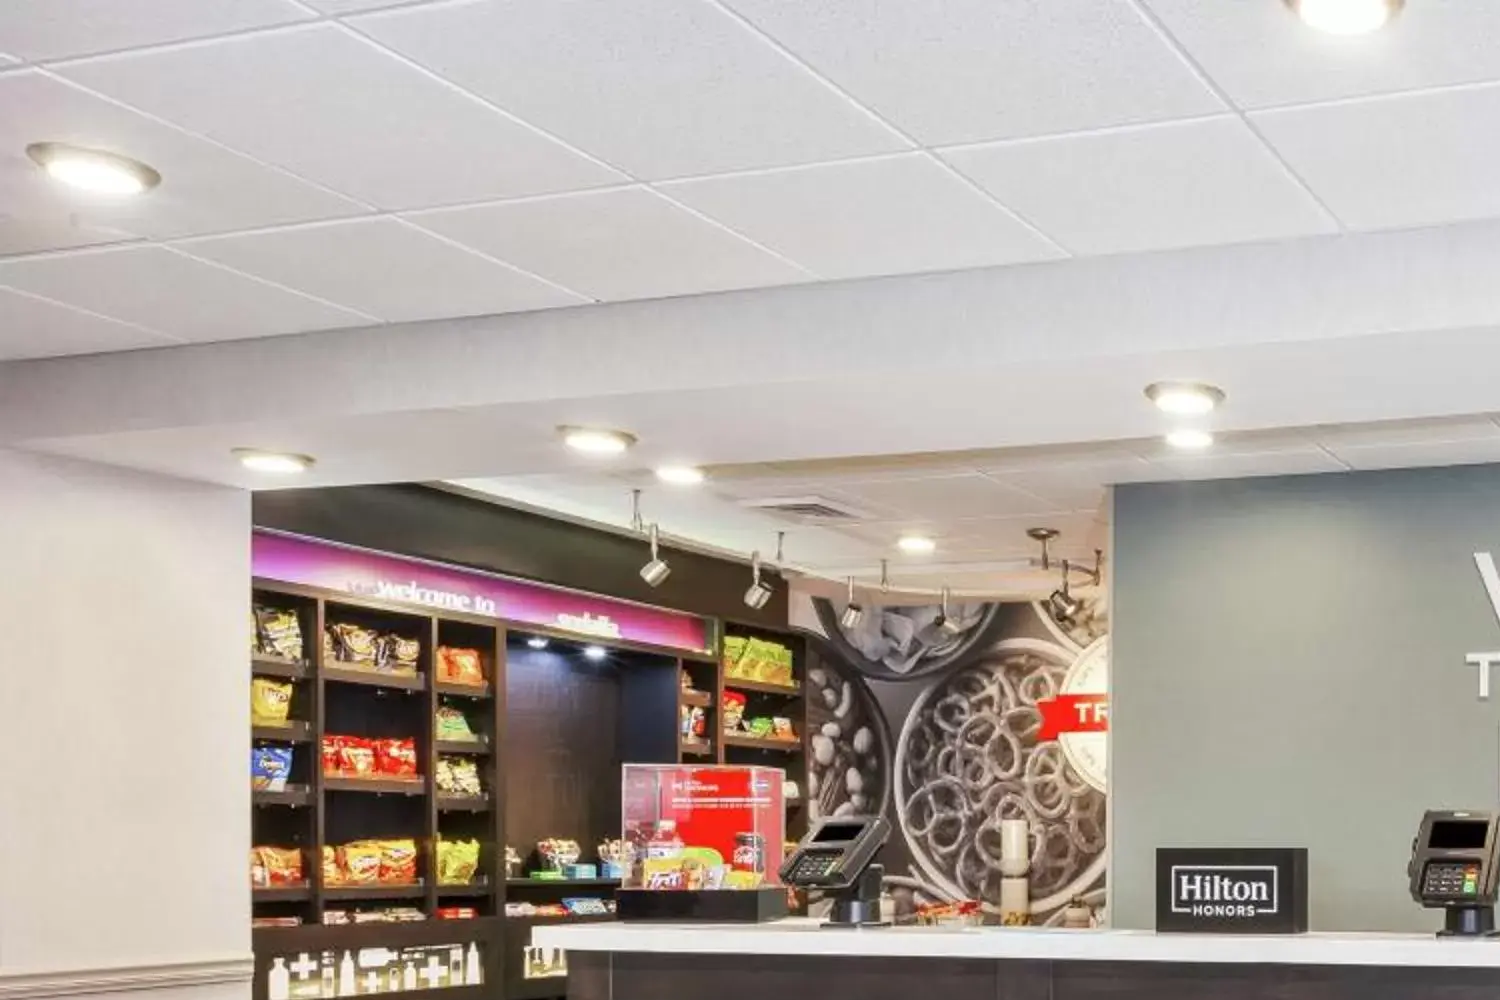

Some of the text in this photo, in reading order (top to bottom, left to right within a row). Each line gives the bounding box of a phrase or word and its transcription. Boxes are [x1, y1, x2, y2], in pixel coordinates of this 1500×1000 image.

[375, 580, 497, 617] welcome to
[1180, 875, 1270, 901] Hilton
[1193, 904, 1256, 917] HONORS
